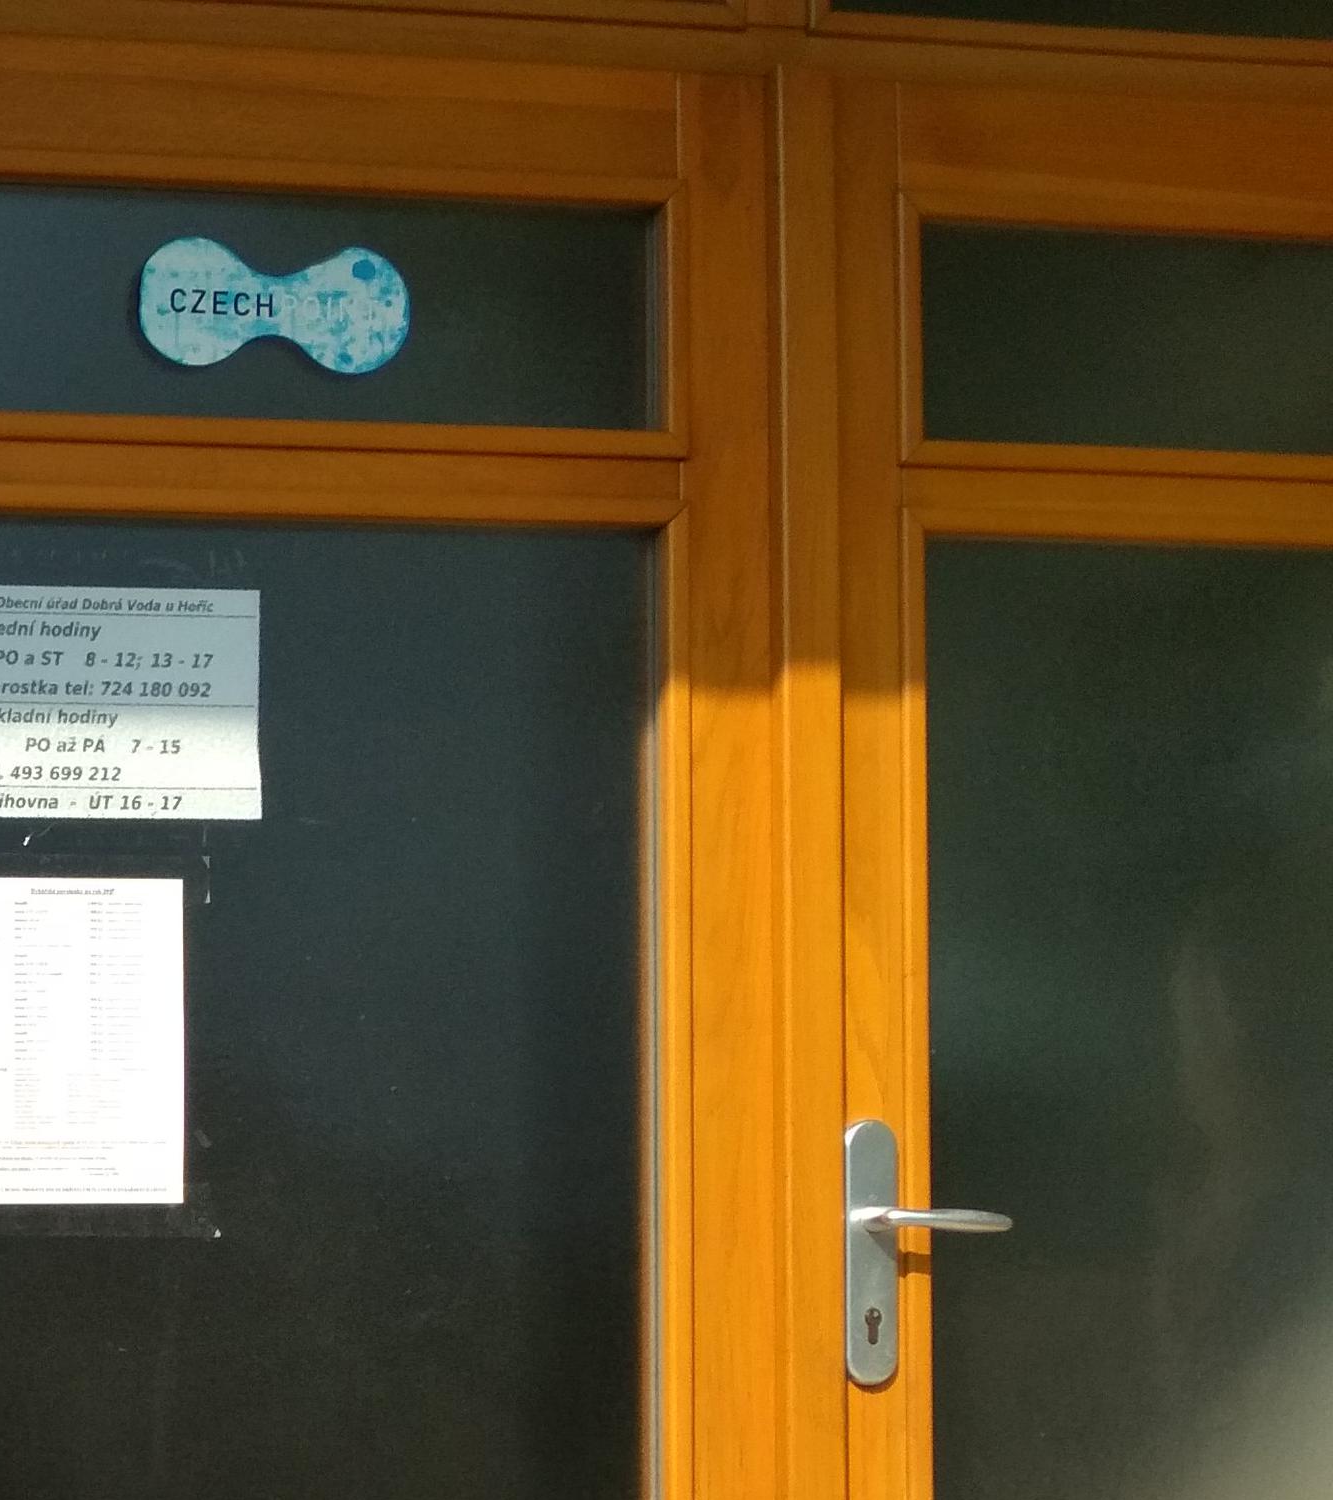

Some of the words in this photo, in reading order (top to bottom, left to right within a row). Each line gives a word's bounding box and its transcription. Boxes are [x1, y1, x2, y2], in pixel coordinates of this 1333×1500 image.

[170, 288, 274, 318] CZECH
[82, 597, 123, 612] Dobrá
[127, 600, 161, 612] Voda
[166, 604, 174, 613] u
[178, 599, 214, 614] Hořic
[39, 621, 102, 642] hodiny
[24, 654, 35, 666] a
[40, 650, 64, 667] ST
[85, 652, 96, 668] 8
[114, 653, 143, 671] 12;
[151, 653, 173, 669] 13
[191, 653, 214, 669] 17
[64, 680, 94, 697] tel:
[101, 681, 134, 697] 724
[139, 681, 173, 698] 180
[177, 682, 212, 699] 092
[57, 708, 119, 730] hodiny
[25, 737, 51, 753] PO
[56, 737, 77, 753] až
[82, 736, 106, 754] PÁ
[131, 739, 142, 754] 7
[160, 739, 182, 755] 15
[10, 766, 44, 781] 493
[49, 766, 84, 782] 699
[88, 766, 121, 782] 212
[119, 794, 143, 811] 16
[160, 794, 183, 811] 17
